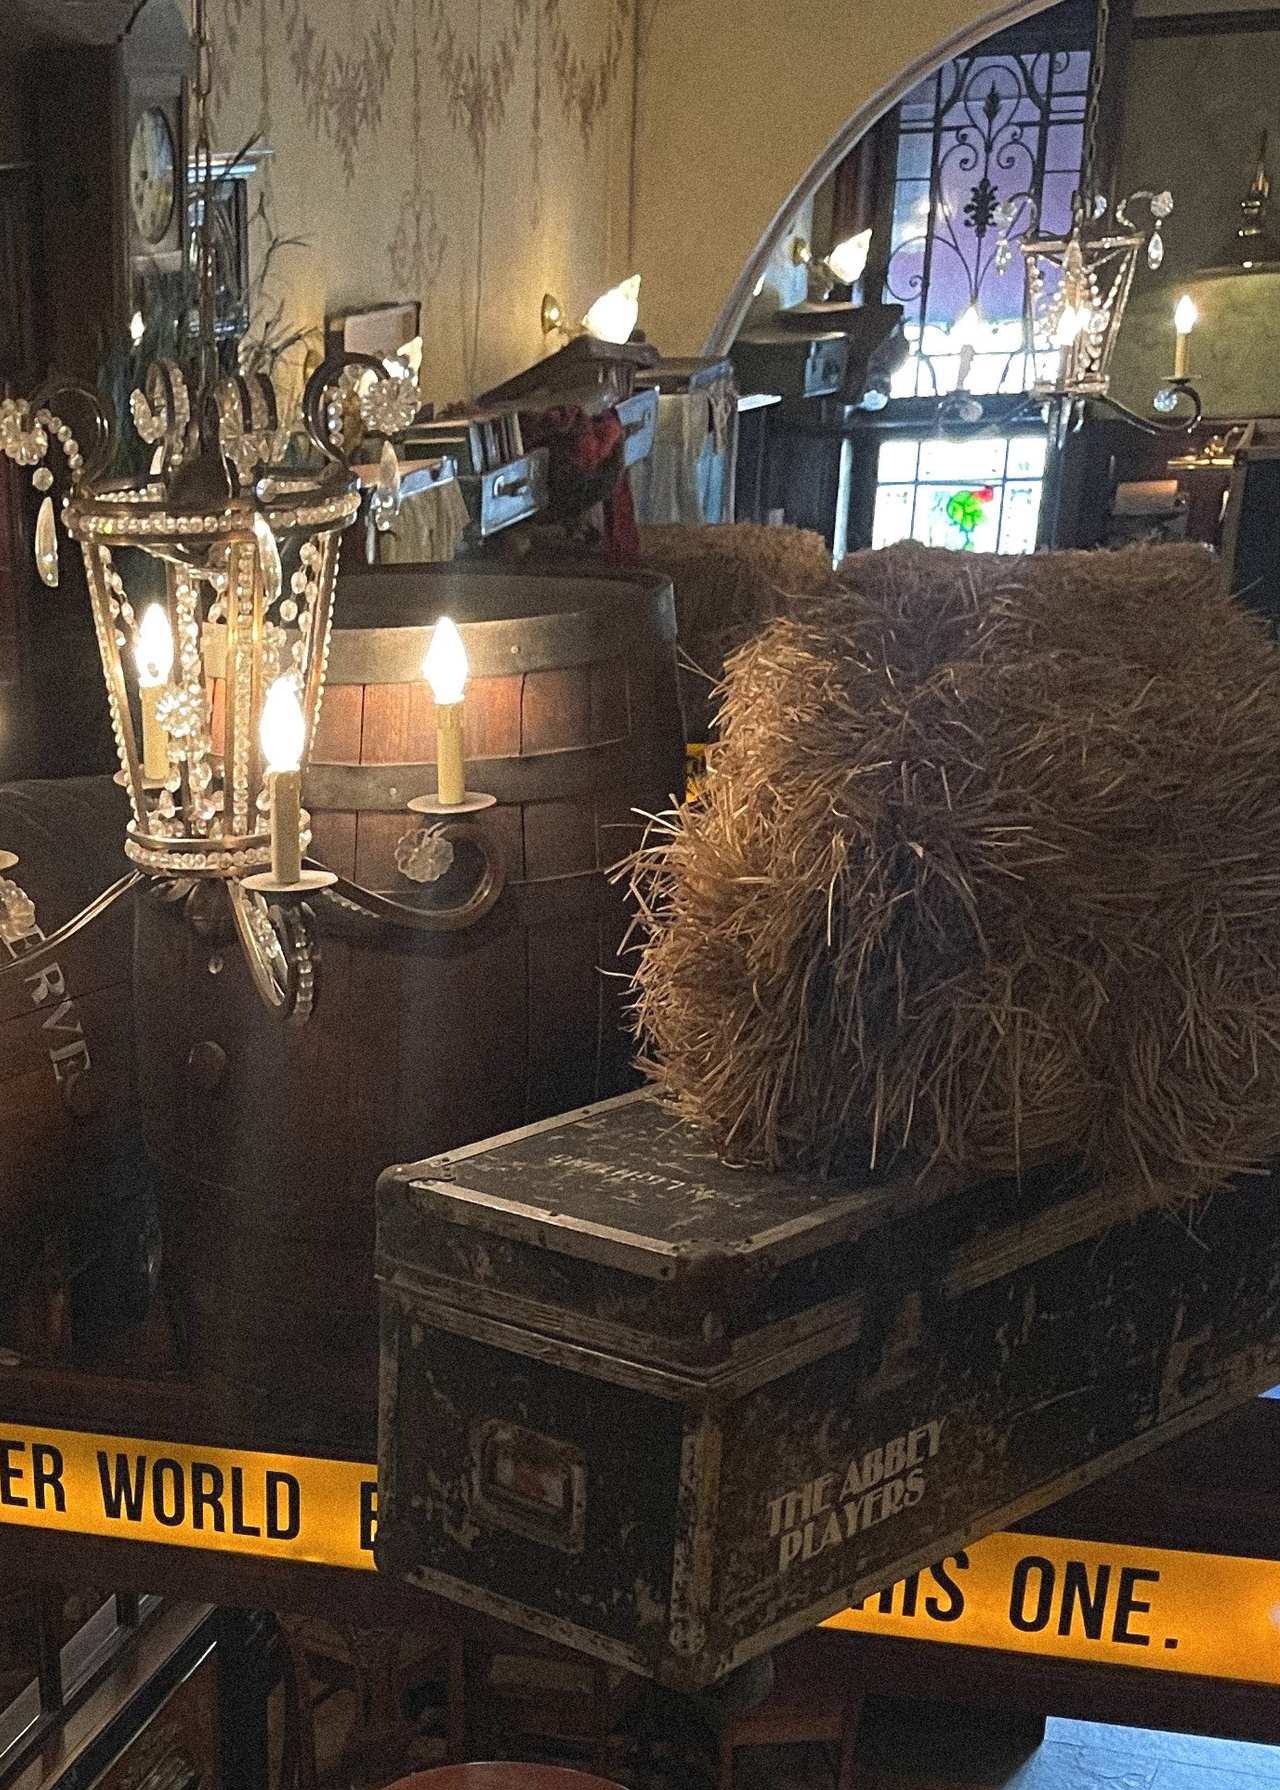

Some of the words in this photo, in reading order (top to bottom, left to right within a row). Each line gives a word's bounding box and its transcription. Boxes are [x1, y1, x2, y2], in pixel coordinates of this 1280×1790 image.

[768, 1472, 834, 1537] THE
[839, 1415, 948, 1502] ABBEY
[778, 1468, 926, 1574] PLAYERS
[97, 1451, 301, 1541] WORLD
[1008, 1555, 1178, 1649] ONE.
